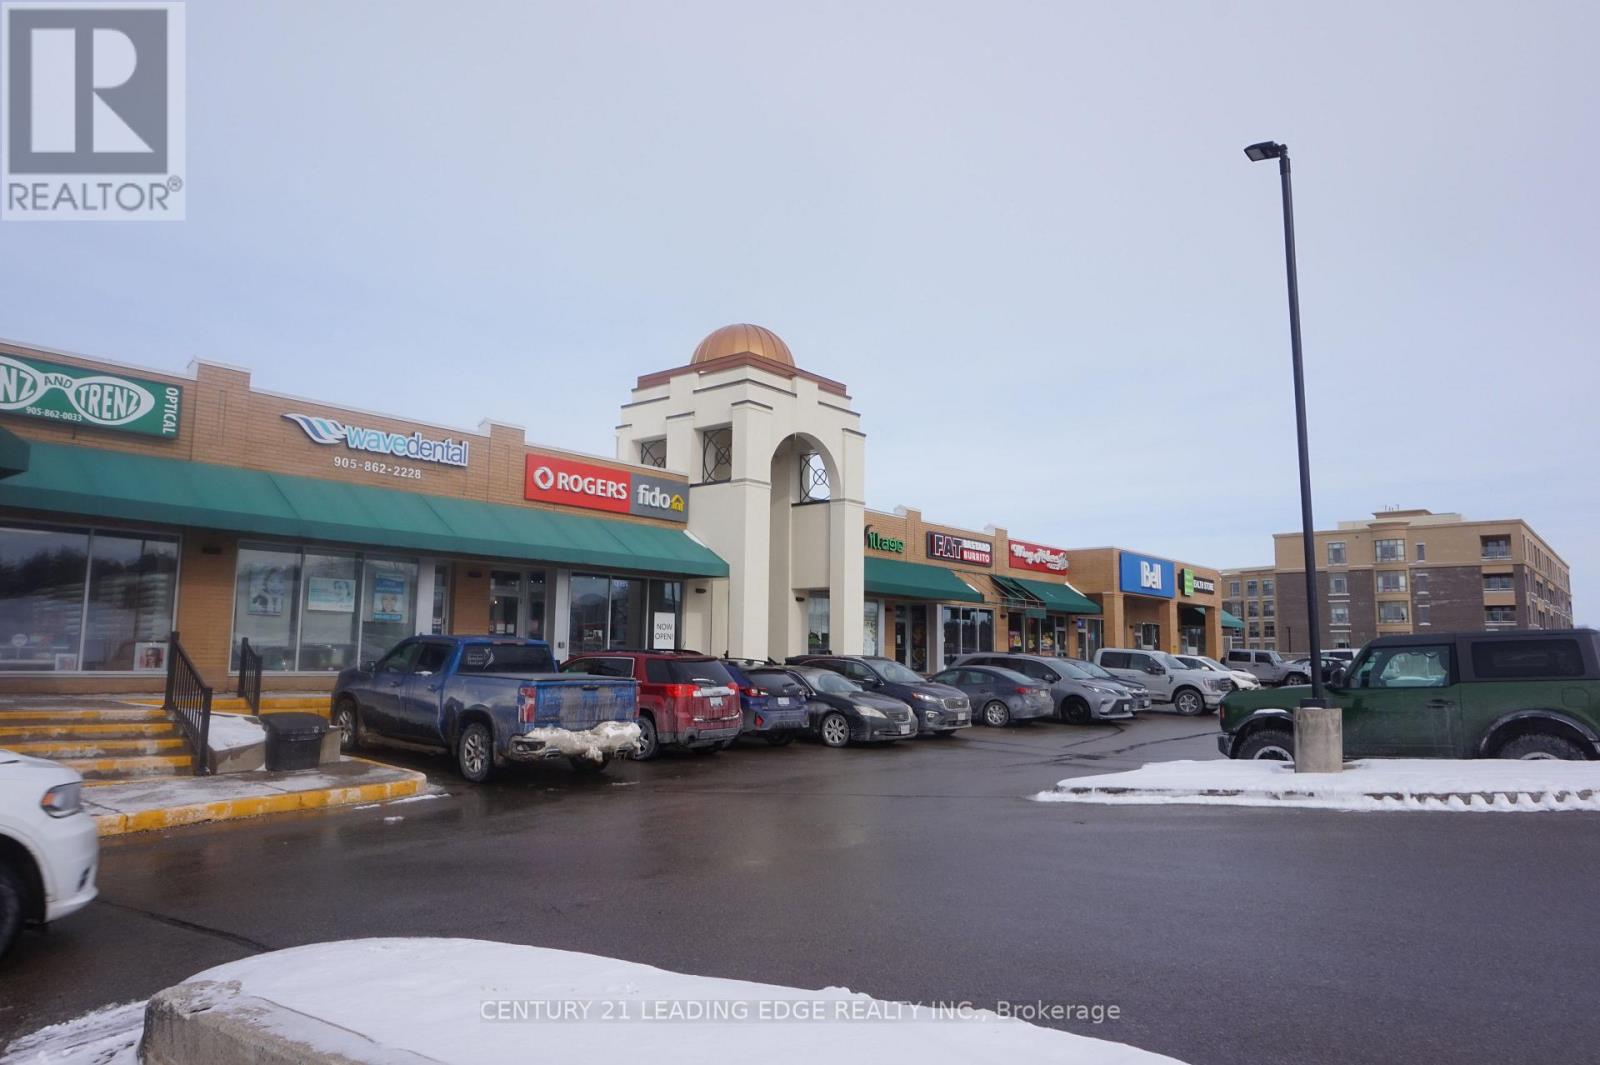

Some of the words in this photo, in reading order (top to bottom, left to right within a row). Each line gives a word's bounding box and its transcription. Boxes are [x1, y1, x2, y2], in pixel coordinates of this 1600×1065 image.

[44, 375, 73, 389] AND
[79, 382, 141, 420] TRENZ
[26, 406, 82, 422] 905-862-0033
[162, 387, 179, 434] OPTICAL
[347, 426, 468, 466] wavedental
[334, 456, 422, 480] 905-862-2228
[556, 472, 628, 500] ROGERS
[637, 484, 671, 509] fido
[934, 534, 962, 559] FAT
[963, 550, 990, 564] BURRITO
[1140, 560, 1162, 590] Bell
[656, 623, 673, 631] NOW
